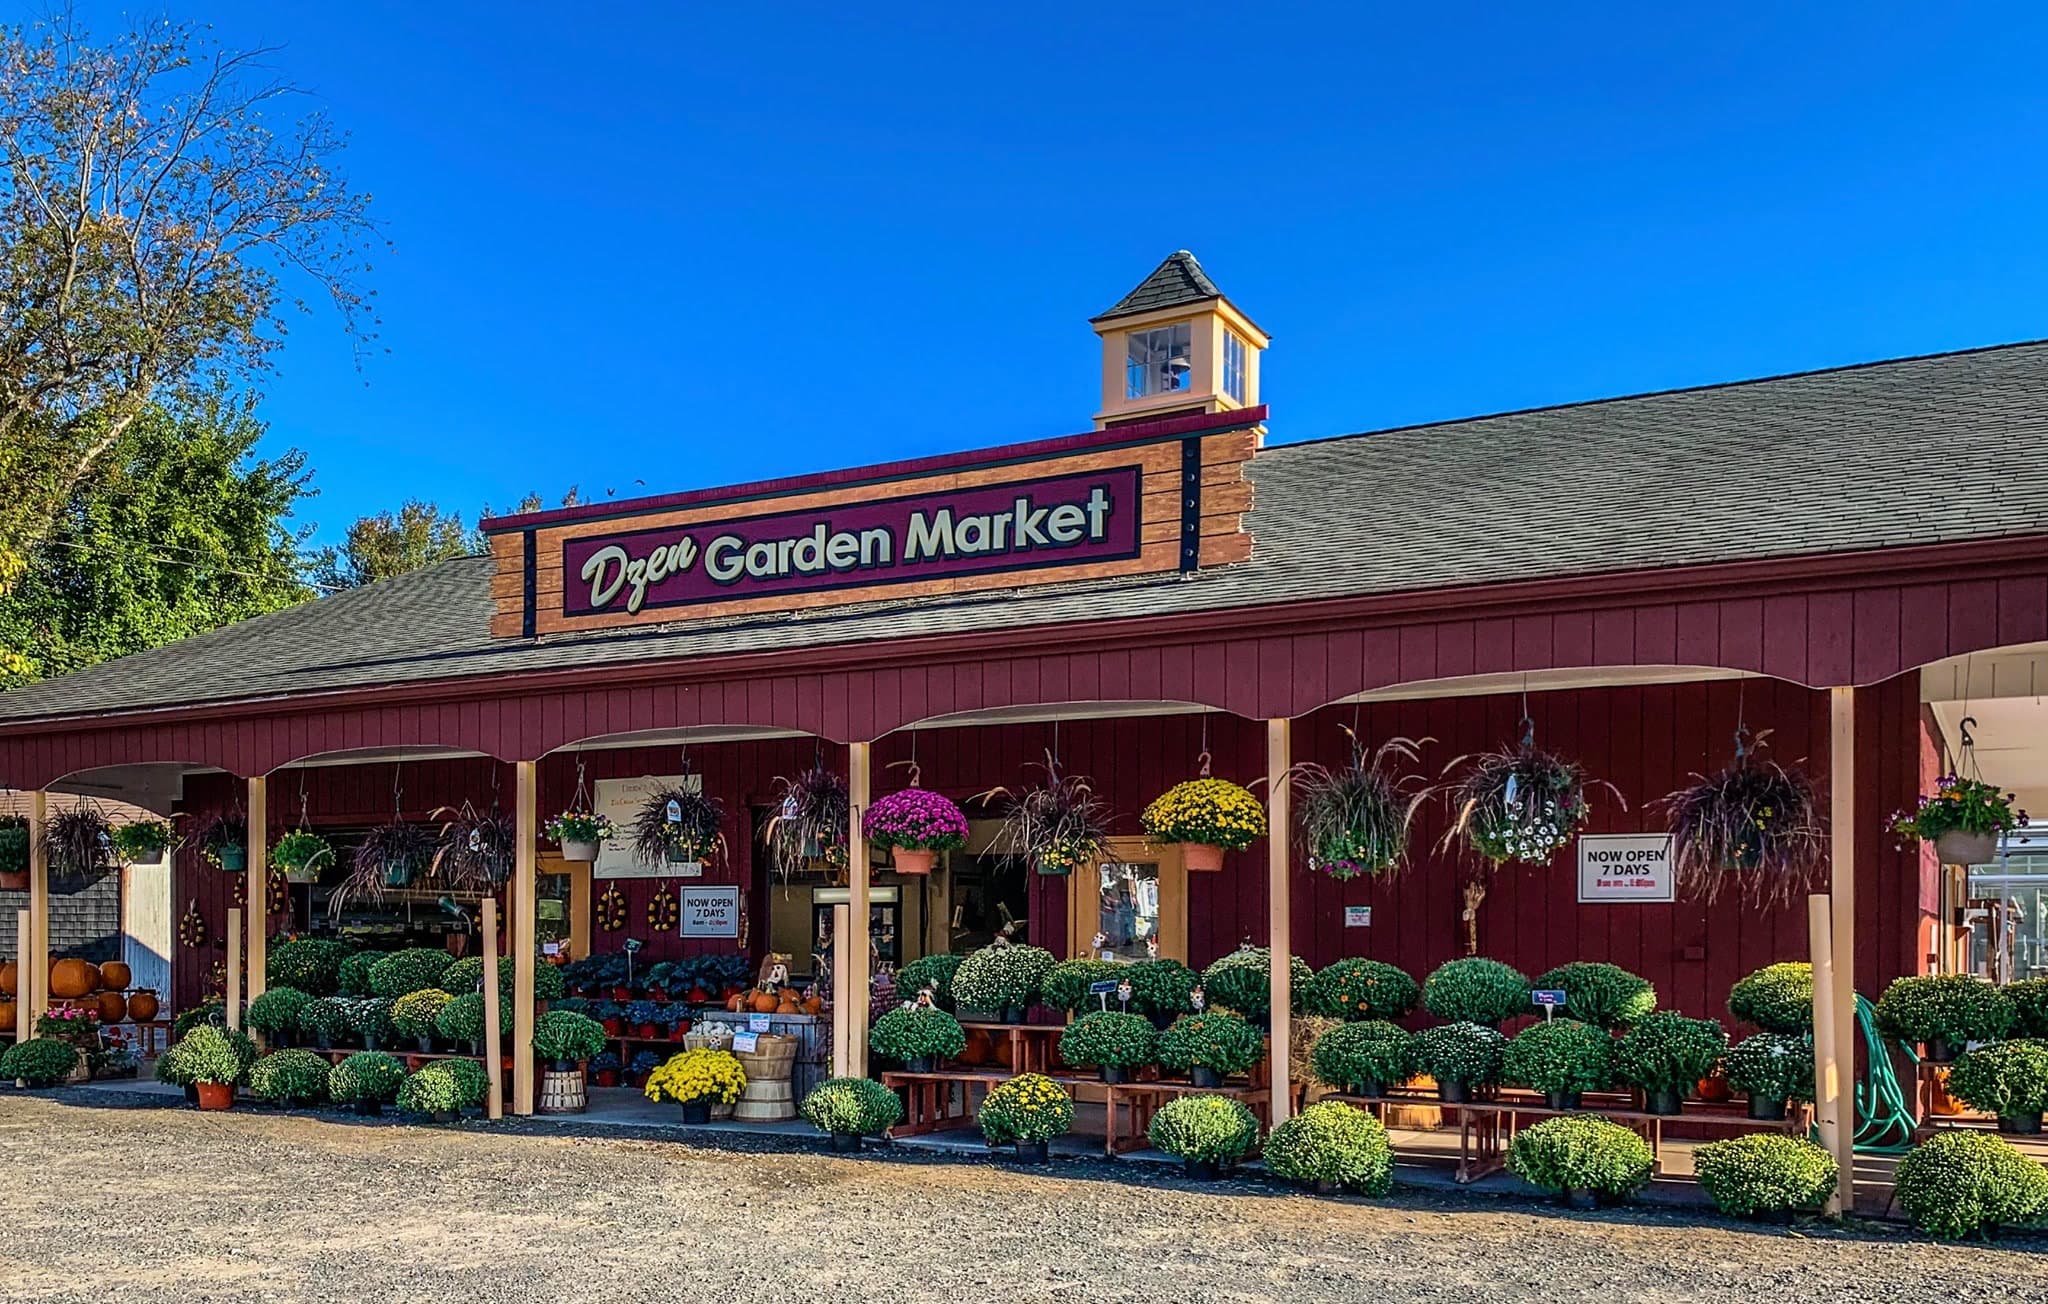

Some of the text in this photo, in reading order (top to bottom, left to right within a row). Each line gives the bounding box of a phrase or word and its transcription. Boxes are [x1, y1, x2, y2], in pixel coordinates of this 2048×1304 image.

[581, 488, 1109, 613] Dzen Garden Market
[1587, 850, 1665, 862] NOW OPEN
[1602, 864, 1650, 875] 7 DAYS
[687, 898, 733, 907] NOW OPEN
[696, 909, 725, 917] 7 DAYS
